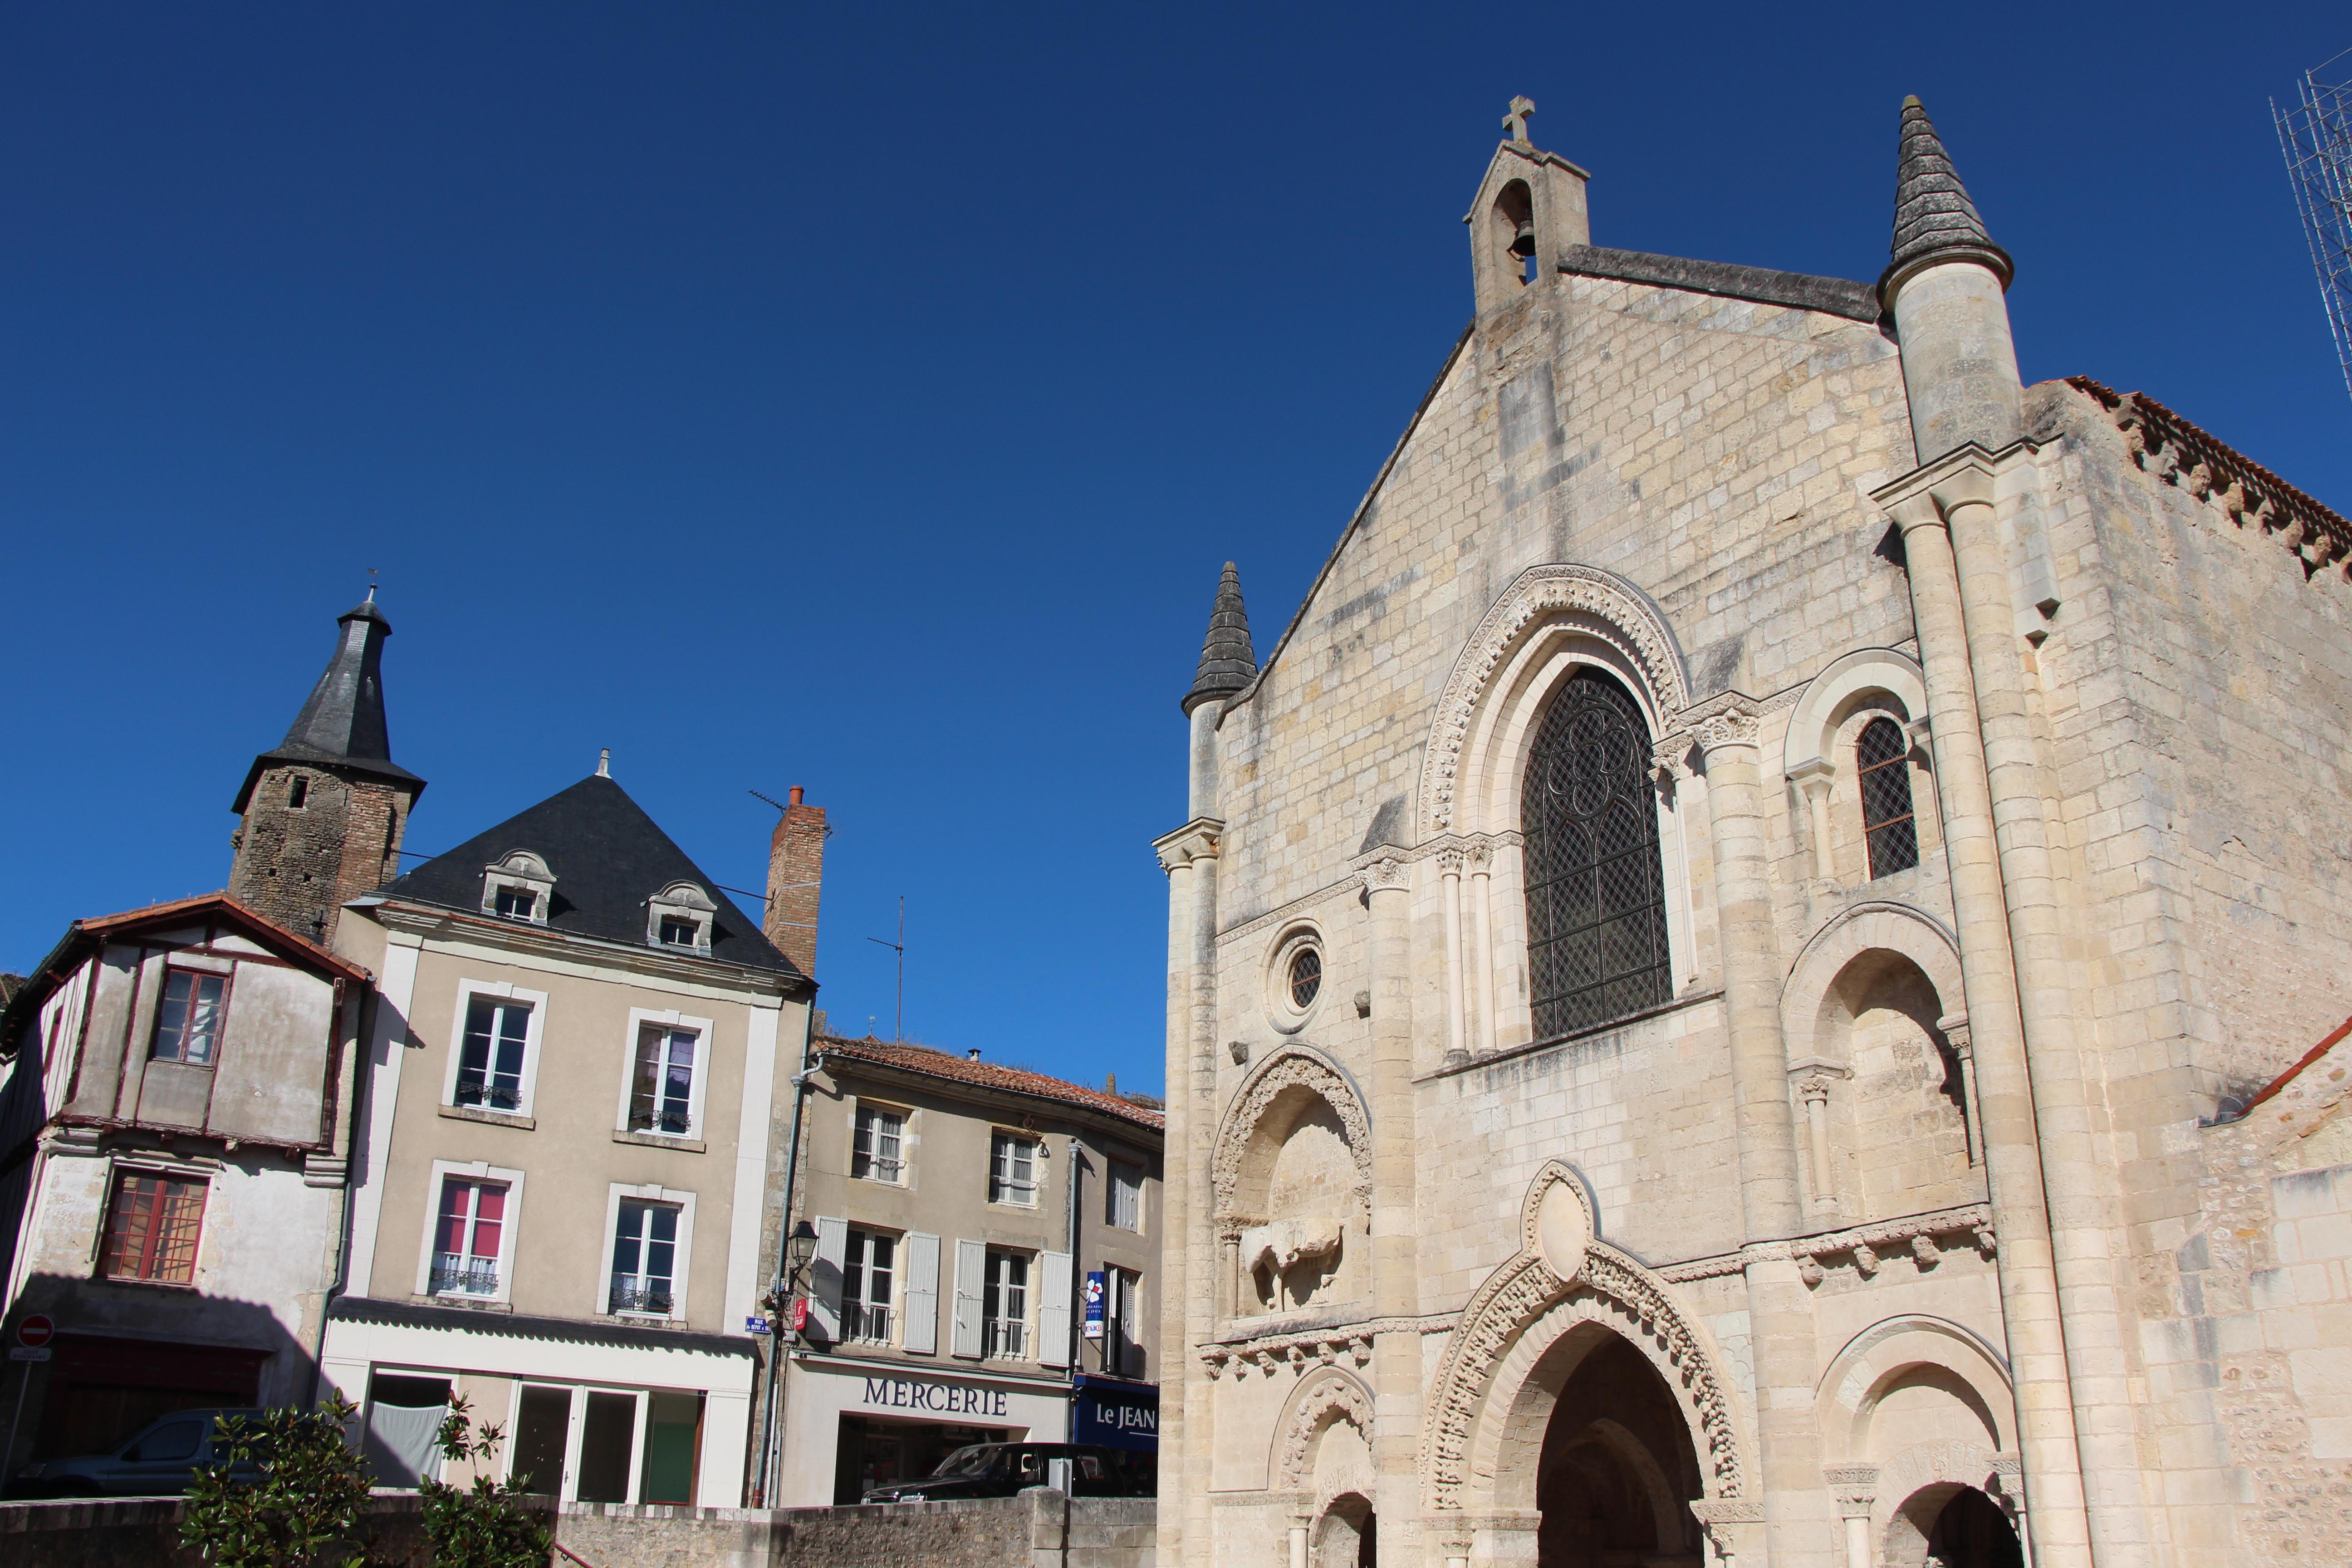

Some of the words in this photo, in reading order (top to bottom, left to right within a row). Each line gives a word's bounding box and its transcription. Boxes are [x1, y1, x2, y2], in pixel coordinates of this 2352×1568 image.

[863, 1377, 1007, 1416] MERCERIE
[1097, 1403, 1114, 1424] Le
[1117, 1406, 1155, 1429] JEAN
